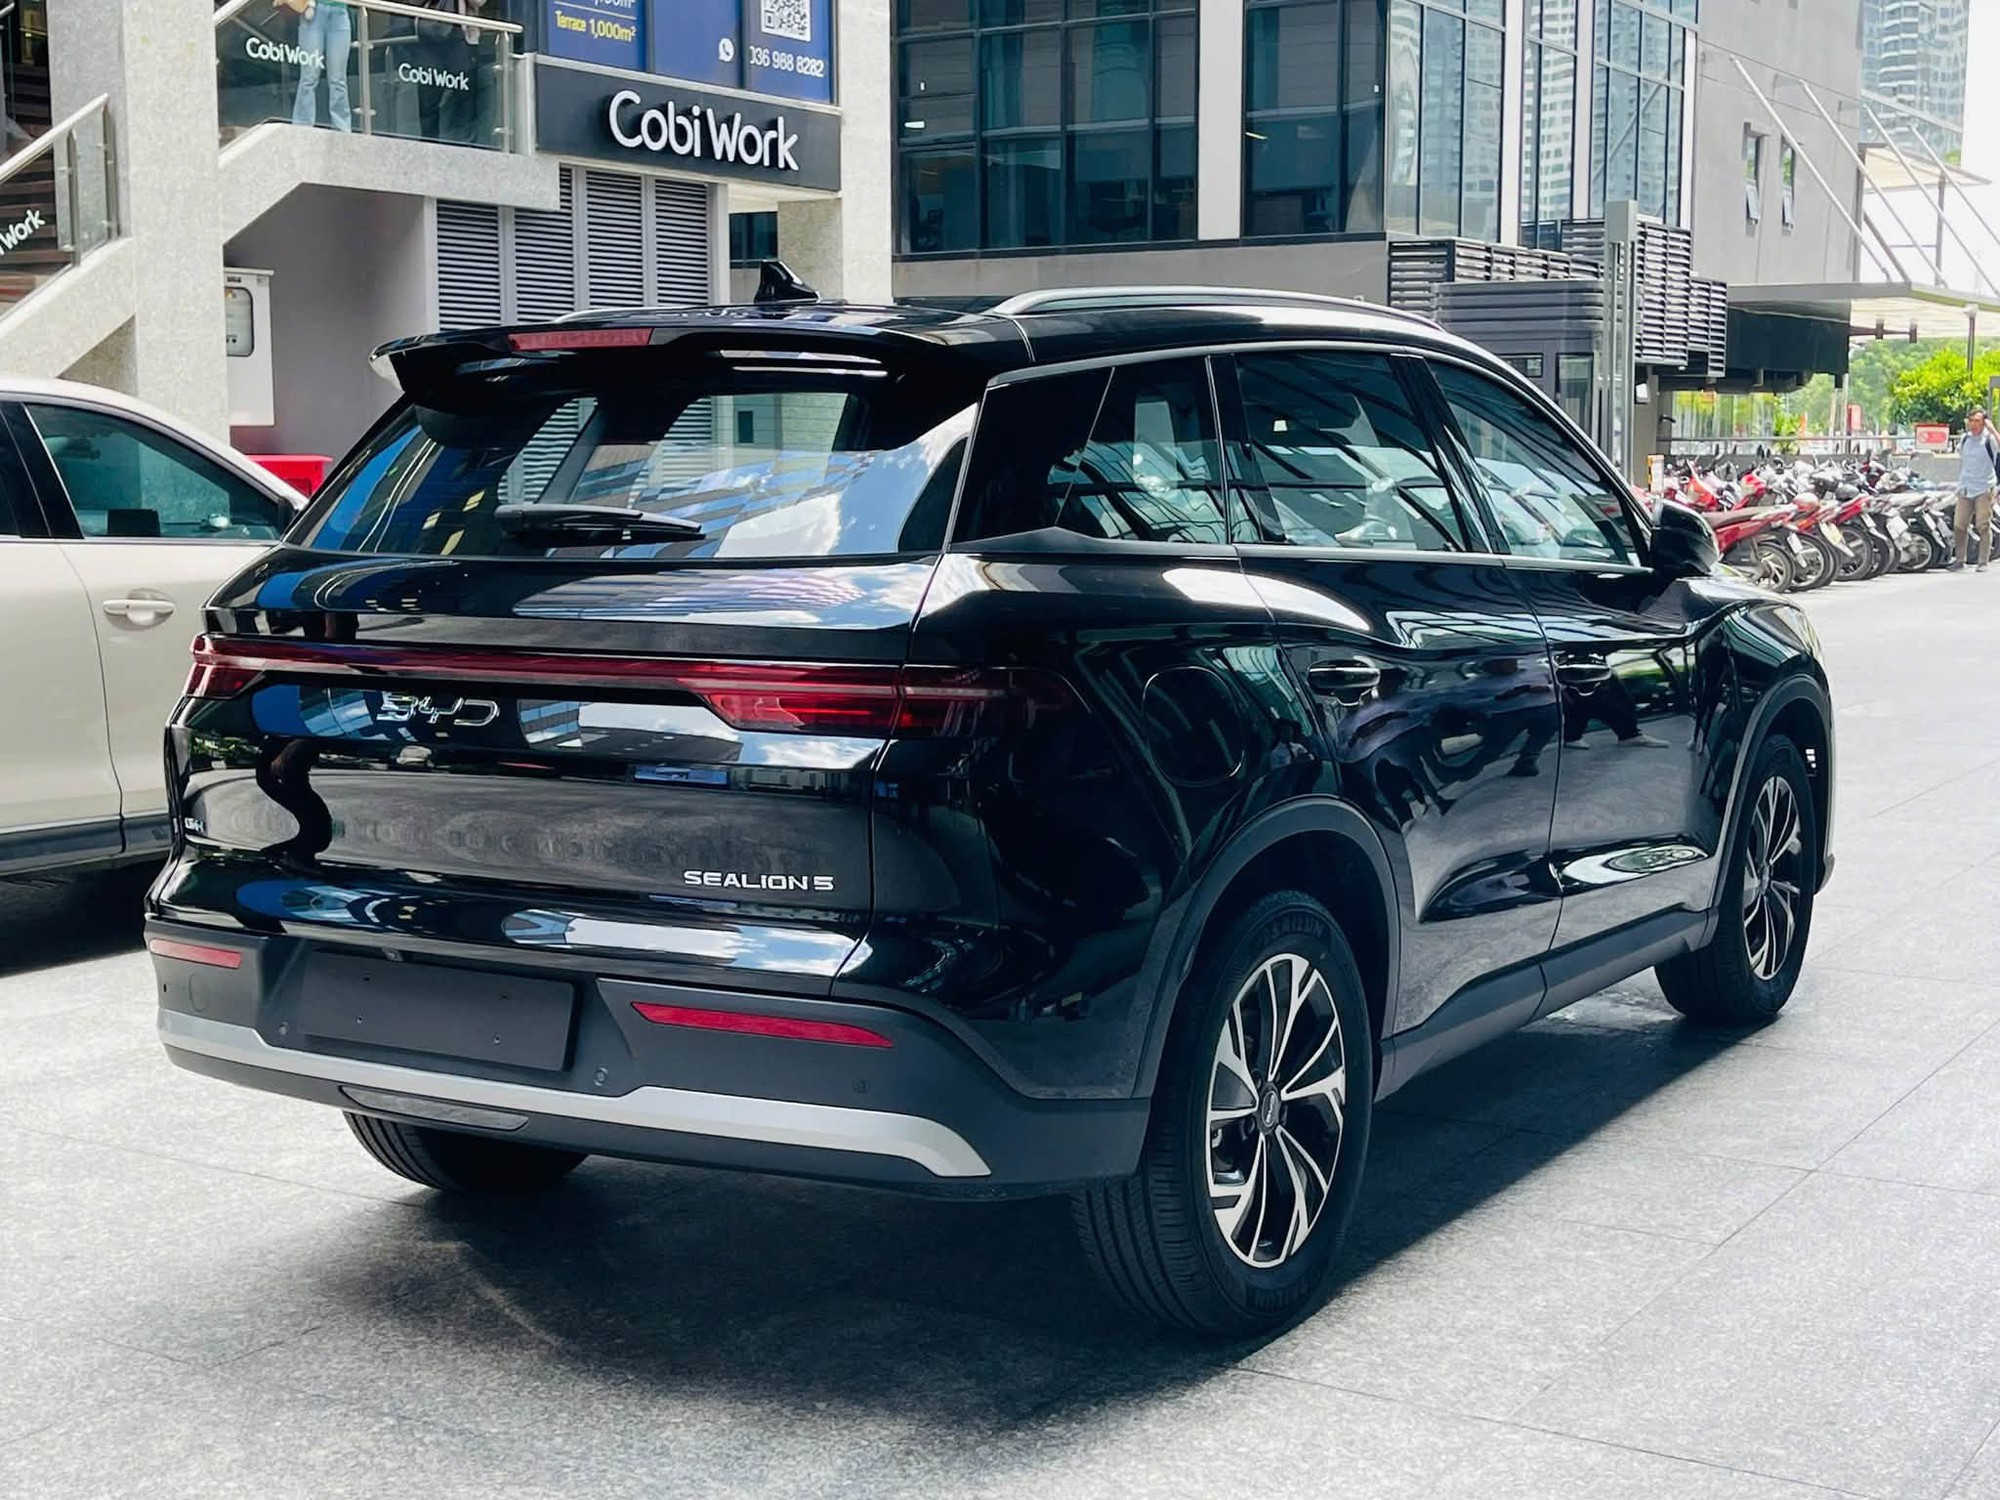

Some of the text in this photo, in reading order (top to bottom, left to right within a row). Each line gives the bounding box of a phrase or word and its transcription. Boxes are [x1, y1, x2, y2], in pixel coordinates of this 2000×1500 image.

[555, 10, 586, 32] Terrace
[772, 51, 794, 72] 988
[796, 56, 825, 78] 8282
[376, 690, 500, 727] BYD
